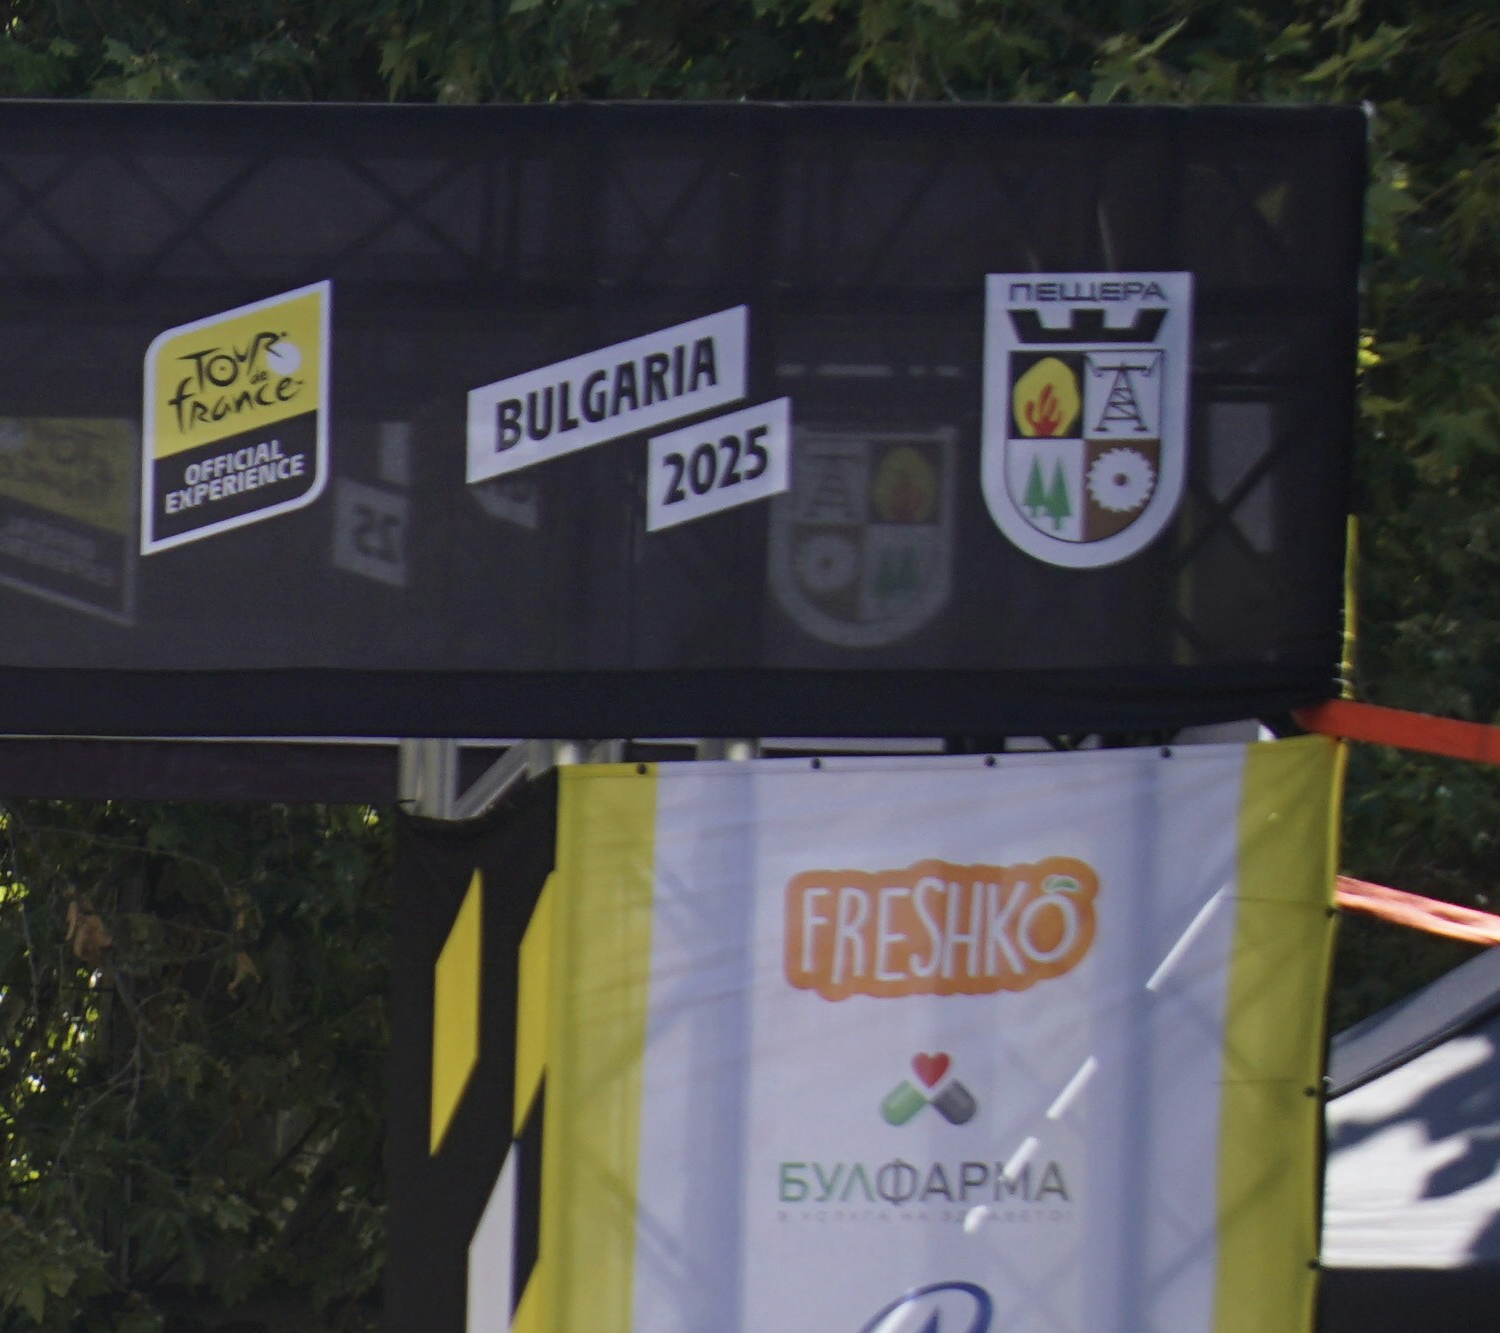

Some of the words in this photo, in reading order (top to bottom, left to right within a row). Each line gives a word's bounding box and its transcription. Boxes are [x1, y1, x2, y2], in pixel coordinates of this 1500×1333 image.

[1008, 280, 1168, 303] ПЕЩЕРА
[494, 336, 719, 454] BULGARIA
[165, 454, 305, 514] EXPERIENCE
[184, 439, 284, 486] OFFICIAL
[661, 426, 770, 505] 2025
[801, 876, 1079, 985] FRESHKO
[778, 1158, 1071, 1206] БУЛФАРМА
